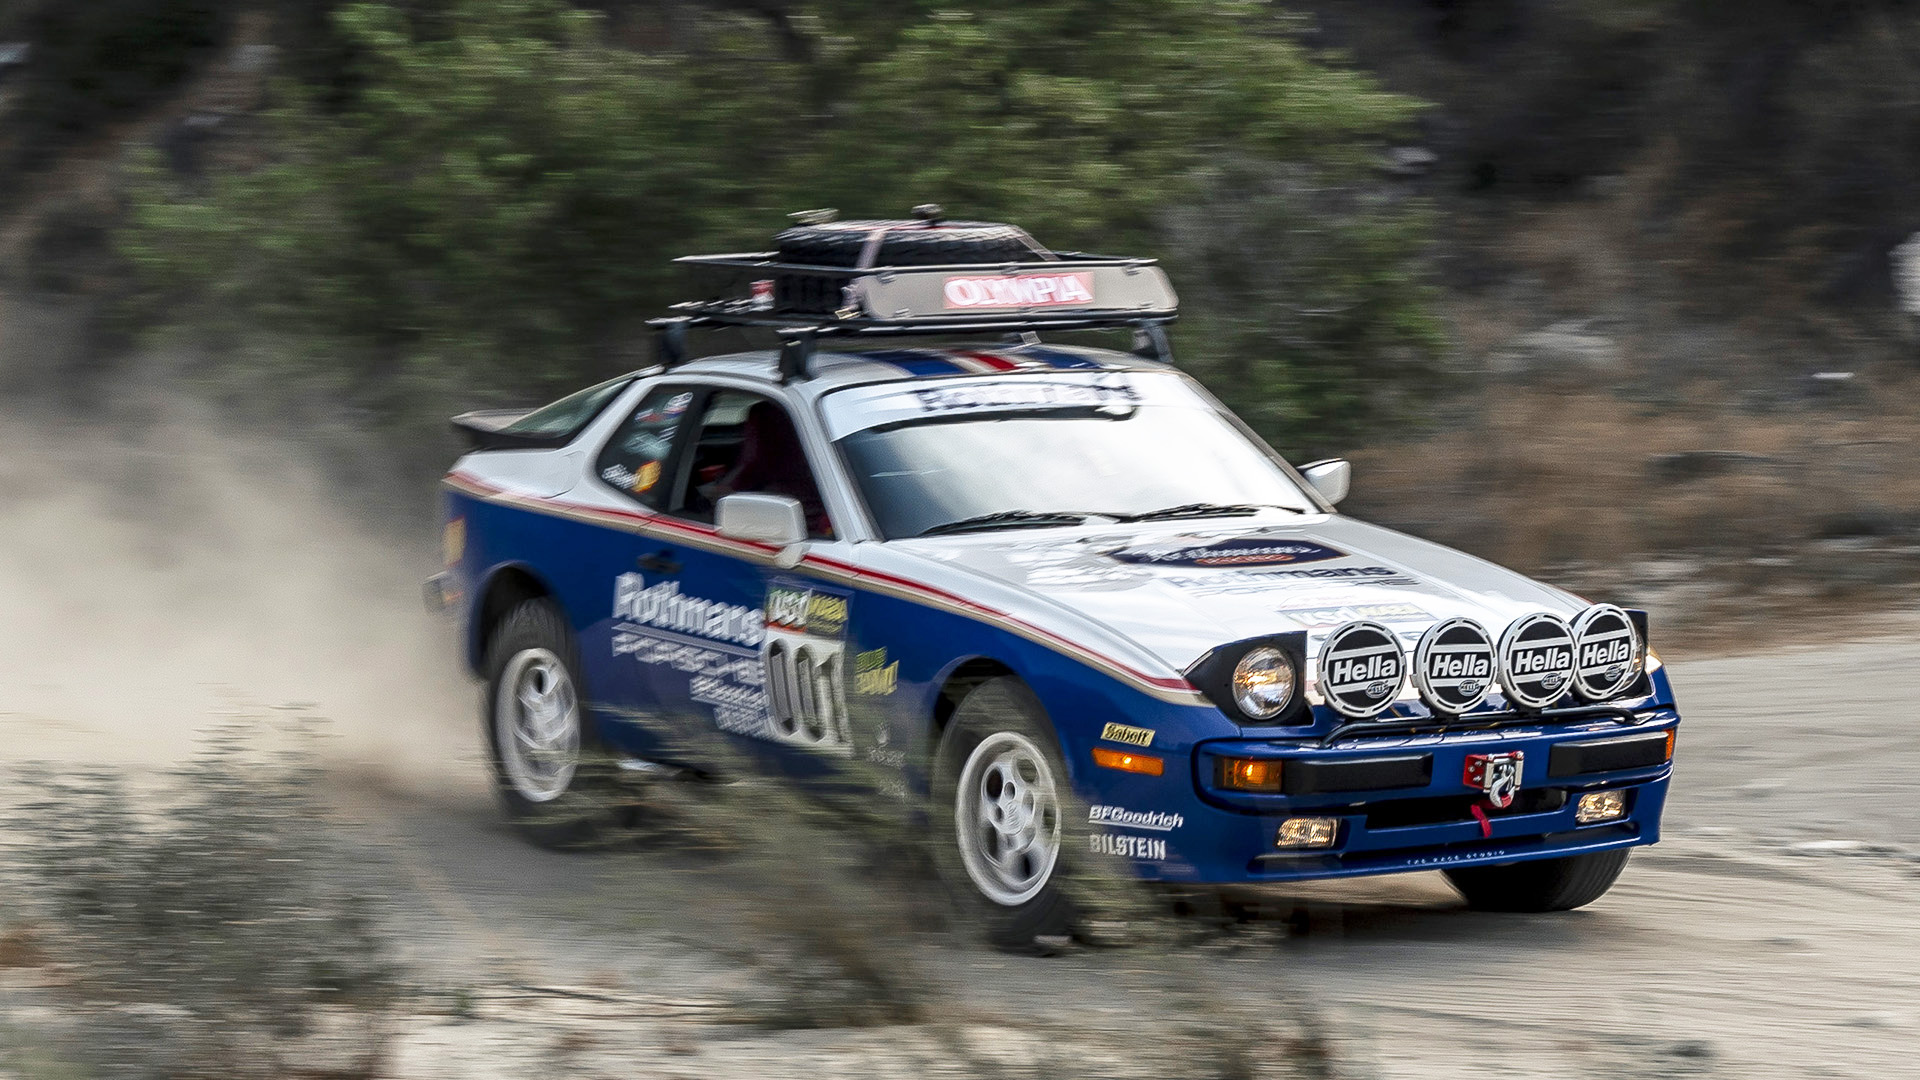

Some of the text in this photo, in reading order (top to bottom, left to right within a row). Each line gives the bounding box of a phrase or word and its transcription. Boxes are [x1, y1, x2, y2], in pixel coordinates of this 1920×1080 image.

[611, 571, 767, 647] Rothmans
[1431, 653, 1489, 677] Hella
[1514, 647, 1571, 674] Hella
[1581, 640, 1630, 667] Hella
[1332, 655, 1396, 684] Hella
[1088, 804, 1184, 828] BFGoodrich
[1089, 833, 1166, 861] BILSTEIN
